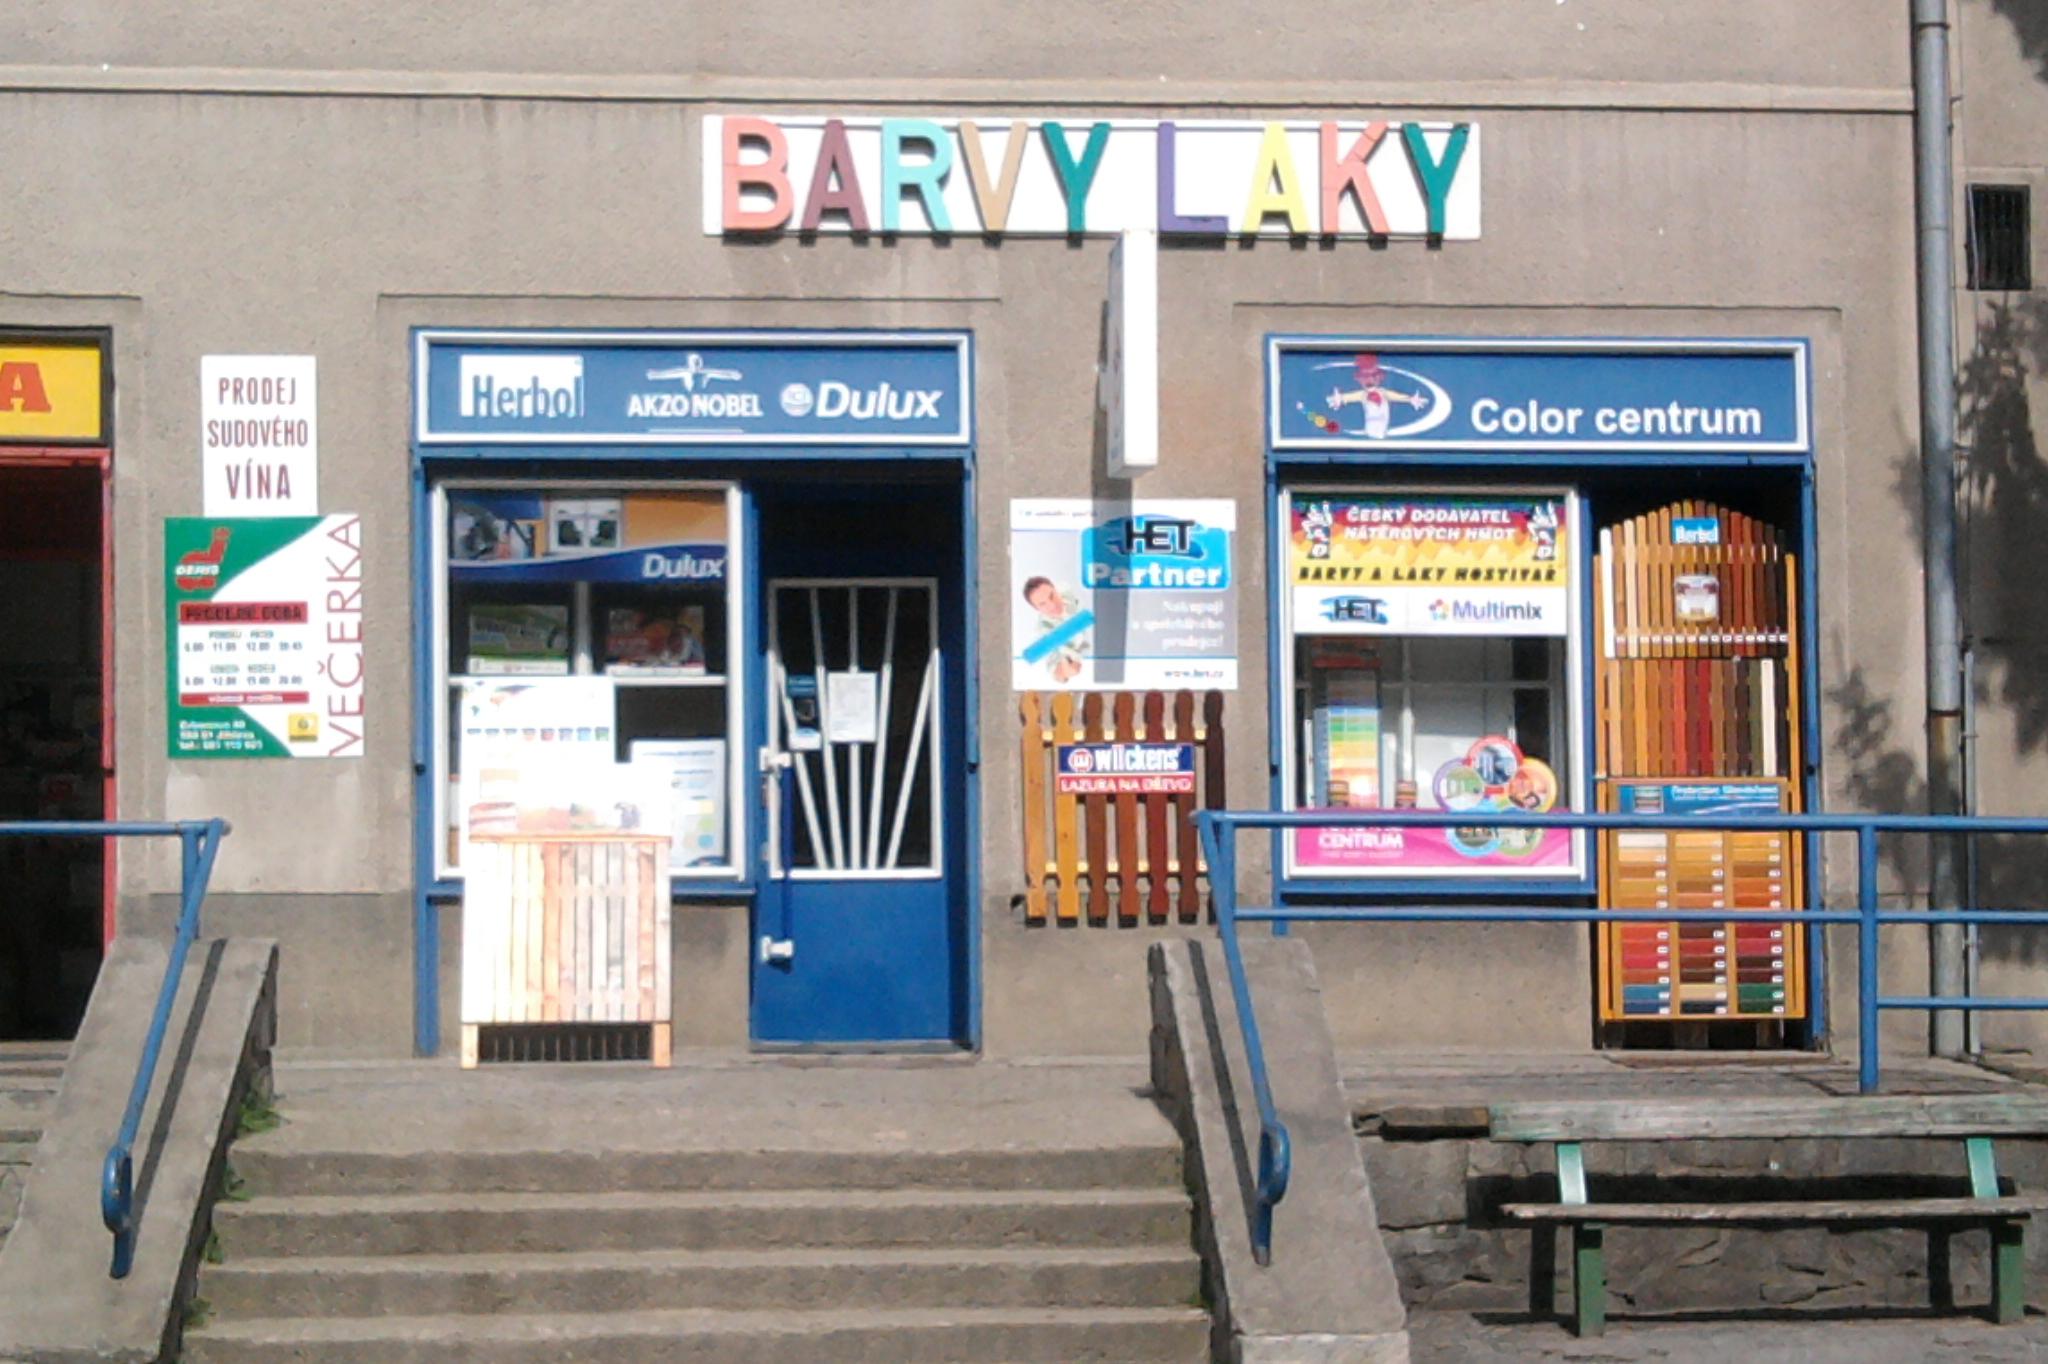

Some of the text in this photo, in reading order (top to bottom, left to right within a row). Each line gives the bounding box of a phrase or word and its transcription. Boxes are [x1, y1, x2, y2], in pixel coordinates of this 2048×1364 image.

[721, 117, 1470, 235] BARVY LAKY
[218, 376, 296, 405] PRODEJ
[473, 374, 583, 419] Herbol
[816, 382, 944, 419] Dulux
[627, 393, 764, 418] AKZO NOBEL
[1470, 398, 1762, 434] Color centrum
[207, 415, 308, 448] SUDOVÉHO
[226, 458, 291, 500] VÍNA
[1346, 505, 1511, 523] ČESKÝ DODAVATEL
[1125, 519, 1195, 553] HET
[1465, 526, 1516, 540] HMOT
[642, 553, 725, 578] Dulux
[1086, 561, 1224, 586] Partner
[1299, 564, 1557, 581] BARVY A LAKY HOSTIVAŘ
[1334, 598, 1543, 621] HET Multimix
[317, 515, 364, 757] VEČERKA
[1060, 777, 1117, 792] LAZURA
[1118, 778, 1140, 791] NA
[1318, 832, 1404, 849] CENTRUM
